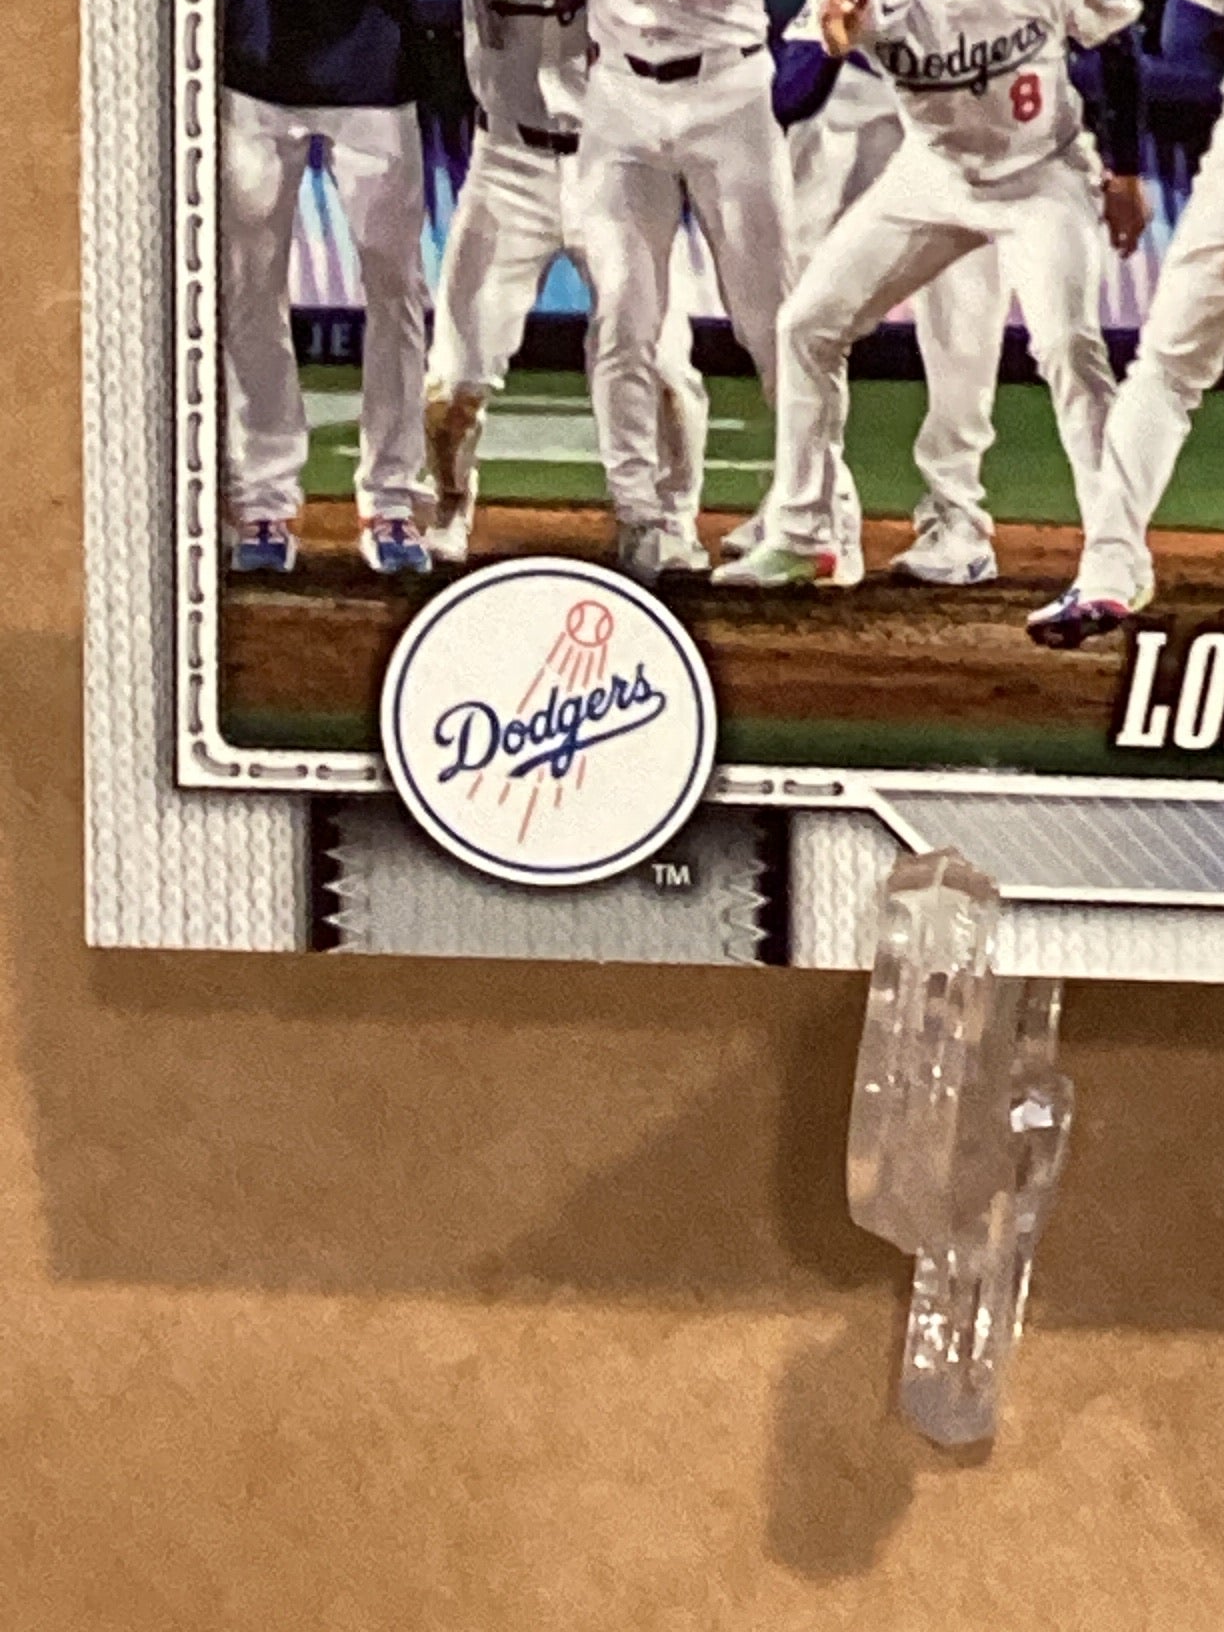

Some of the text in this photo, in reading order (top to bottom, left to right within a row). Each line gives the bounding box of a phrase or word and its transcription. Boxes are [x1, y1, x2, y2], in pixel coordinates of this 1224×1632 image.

[874, 16, 1048, 100] Dodgers
[1008, 71, 1042, 123] 8
[434, 662, 667, 785] Dodgers
